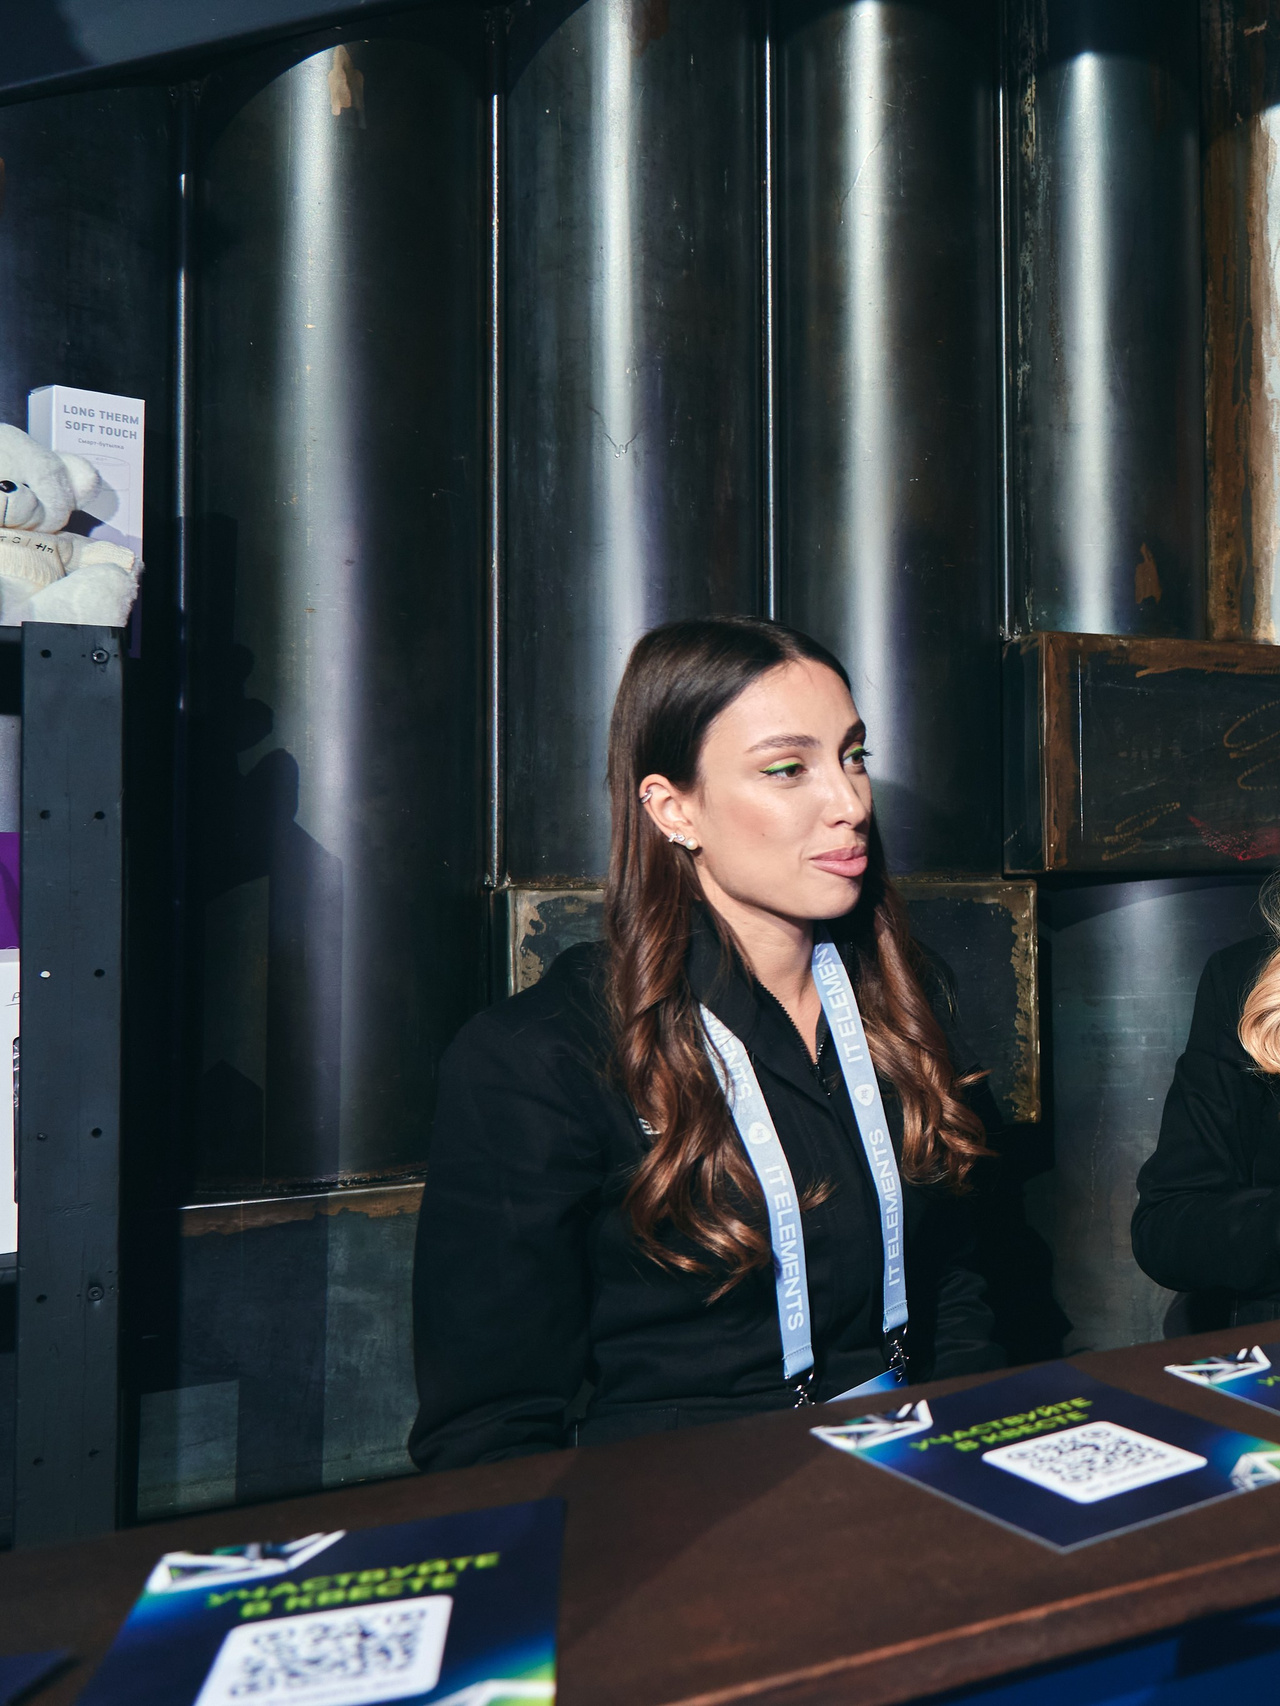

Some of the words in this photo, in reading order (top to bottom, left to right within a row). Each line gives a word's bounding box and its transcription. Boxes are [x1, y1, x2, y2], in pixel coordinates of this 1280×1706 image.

[63, 405, 96, 418] LONG
[99, 410, 139, 425] THERM
[65, 420, 95, 433] SOFT
[99, 425, 137, 440] TOUCH
[814, 943, 857, 1038] ELEMENT
[702, 1008, 753, 1101] MENTS
[843, 1042, 864, 1063] IT
[764, 1165, 787, 1187] IT
[868, 1128, 900, 1261] ELEMENTS
[774, 1190, 804, 1331] ELEMENTS
[888, 1264, 901, 1287] IT
[980, 1410, 1089, 1445] КВЕСТЕ
